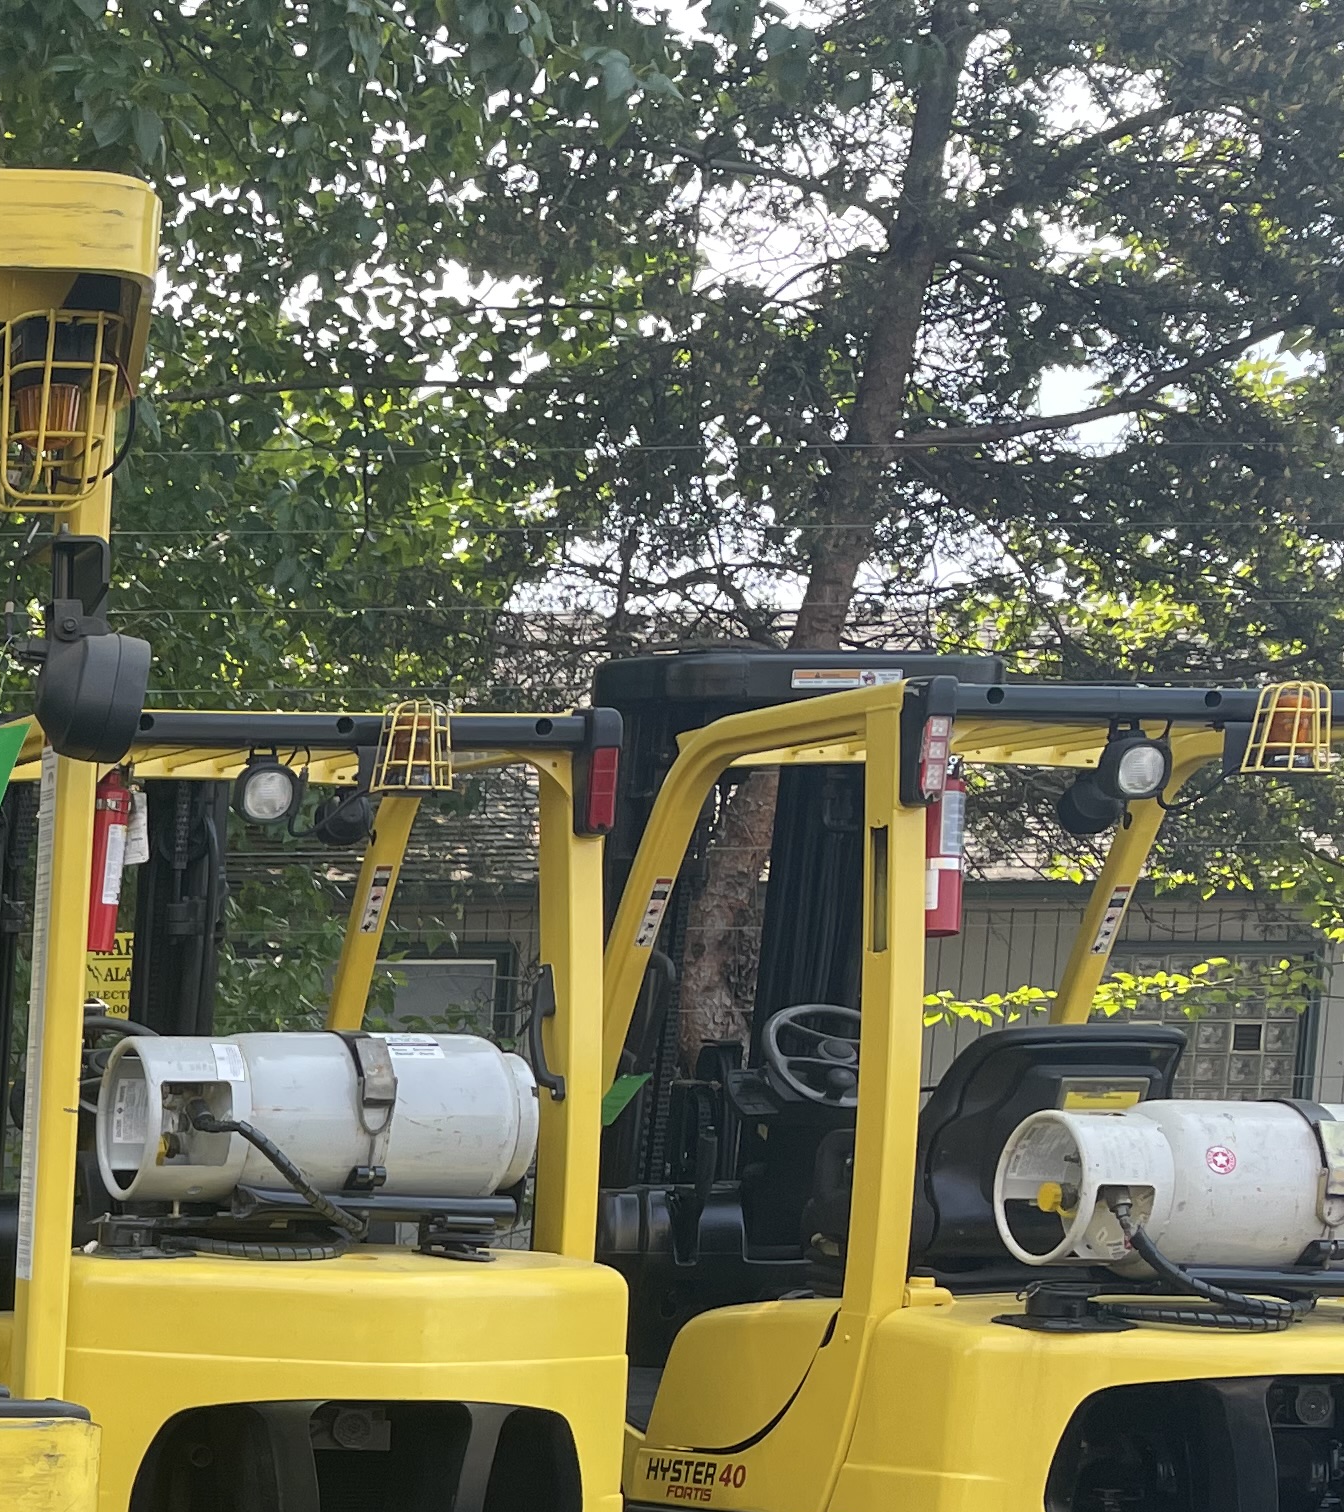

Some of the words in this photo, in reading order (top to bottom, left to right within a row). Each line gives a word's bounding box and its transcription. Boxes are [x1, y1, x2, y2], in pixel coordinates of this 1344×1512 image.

[88, 990, 130, 1000] ELECT
[645, 1458, 717, 1486] HYSTER
[719, 1463, 746, 1488] 40
[666, 1485, 712, 1502] FORTIS
